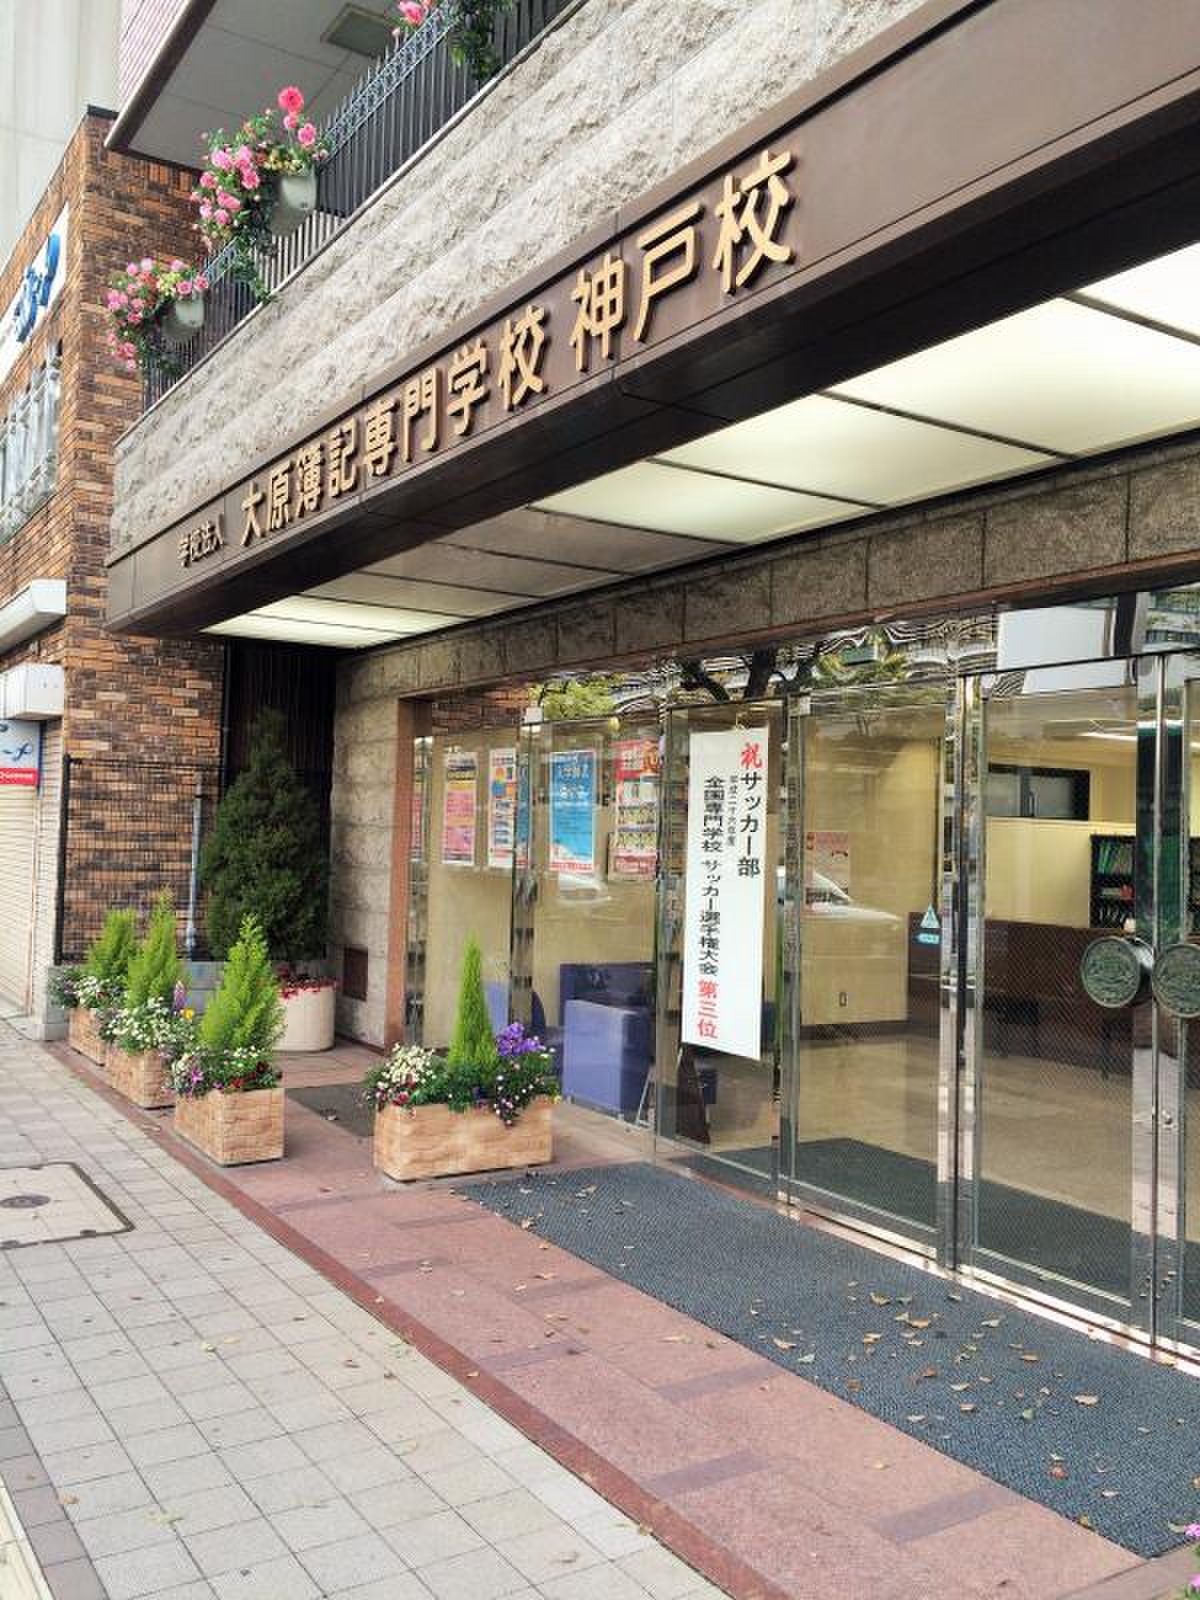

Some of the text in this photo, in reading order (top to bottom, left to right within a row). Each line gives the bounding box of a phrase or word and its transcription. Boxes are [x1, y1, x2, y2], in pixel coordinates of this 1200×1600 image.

[240, 303, 548, 547] 大原簿記専門学校
[569, 150, 797, 373] 神戸校
[701, 775, 724, 853] 全国専門学校
